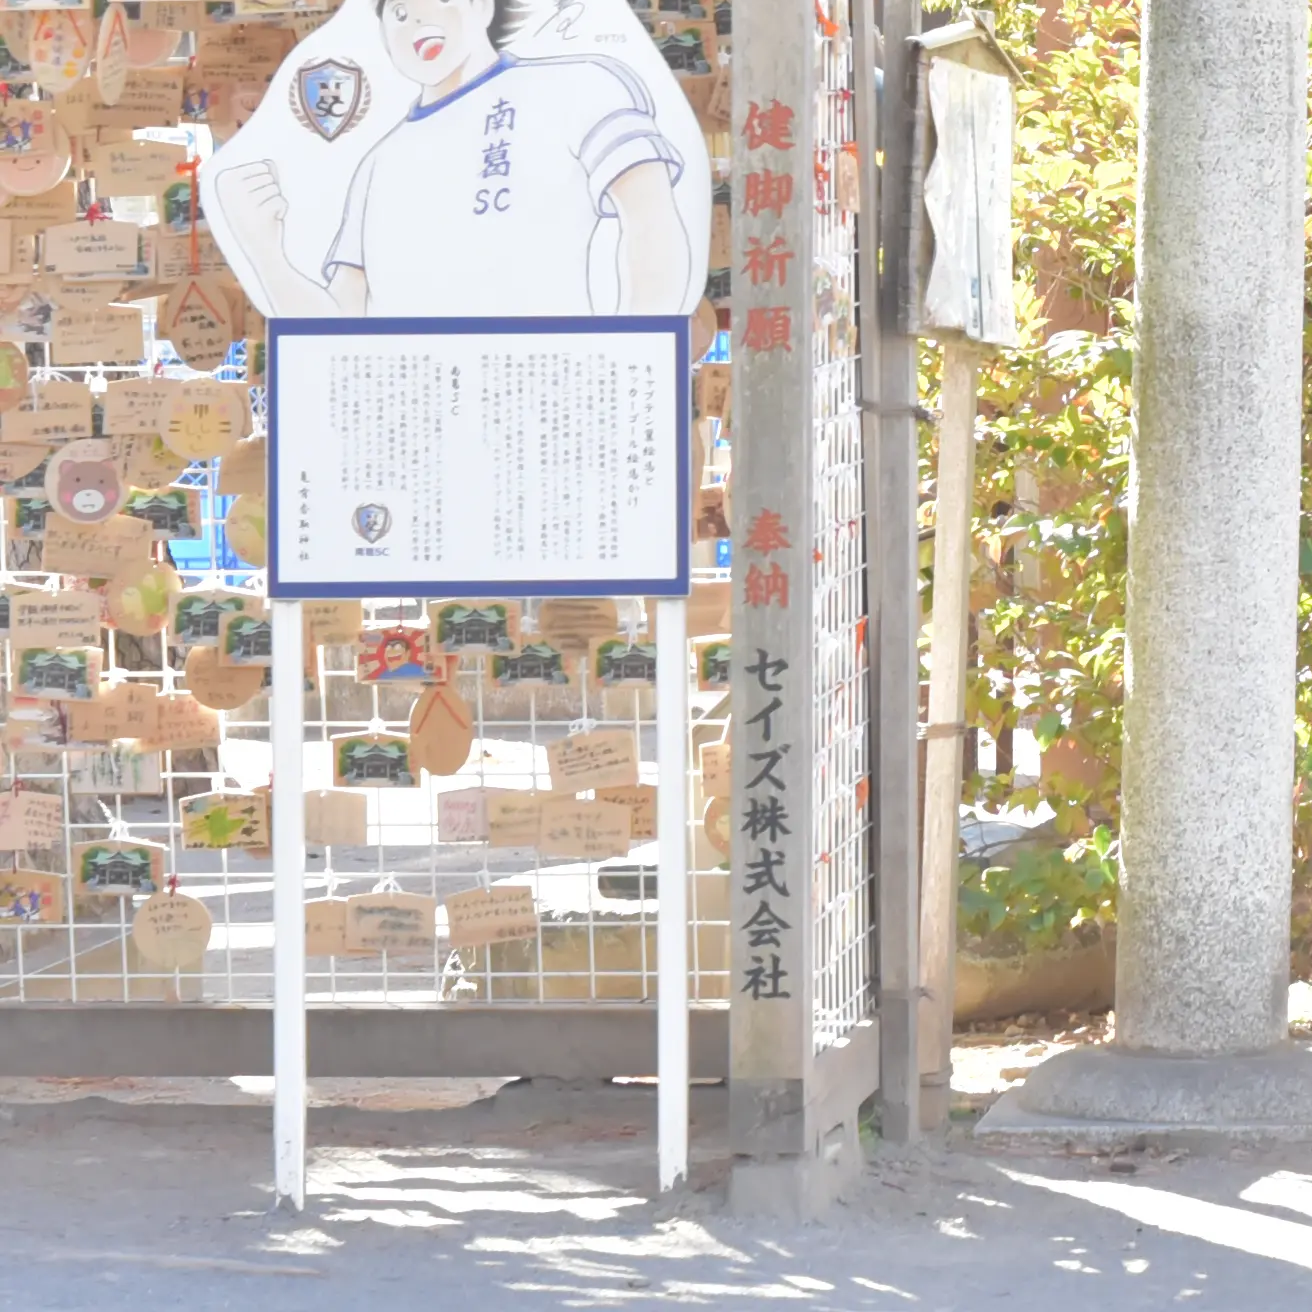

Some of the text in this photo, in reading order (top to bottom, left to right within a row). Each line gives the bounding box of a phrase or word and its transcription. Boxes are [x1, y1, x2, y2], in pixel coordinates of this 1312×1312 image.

[741, 100, 796, 354] 健脚祈願
[742, 508, 794, 608] 奉納
[740, 650, 795, 1001] セイズ株式会社
